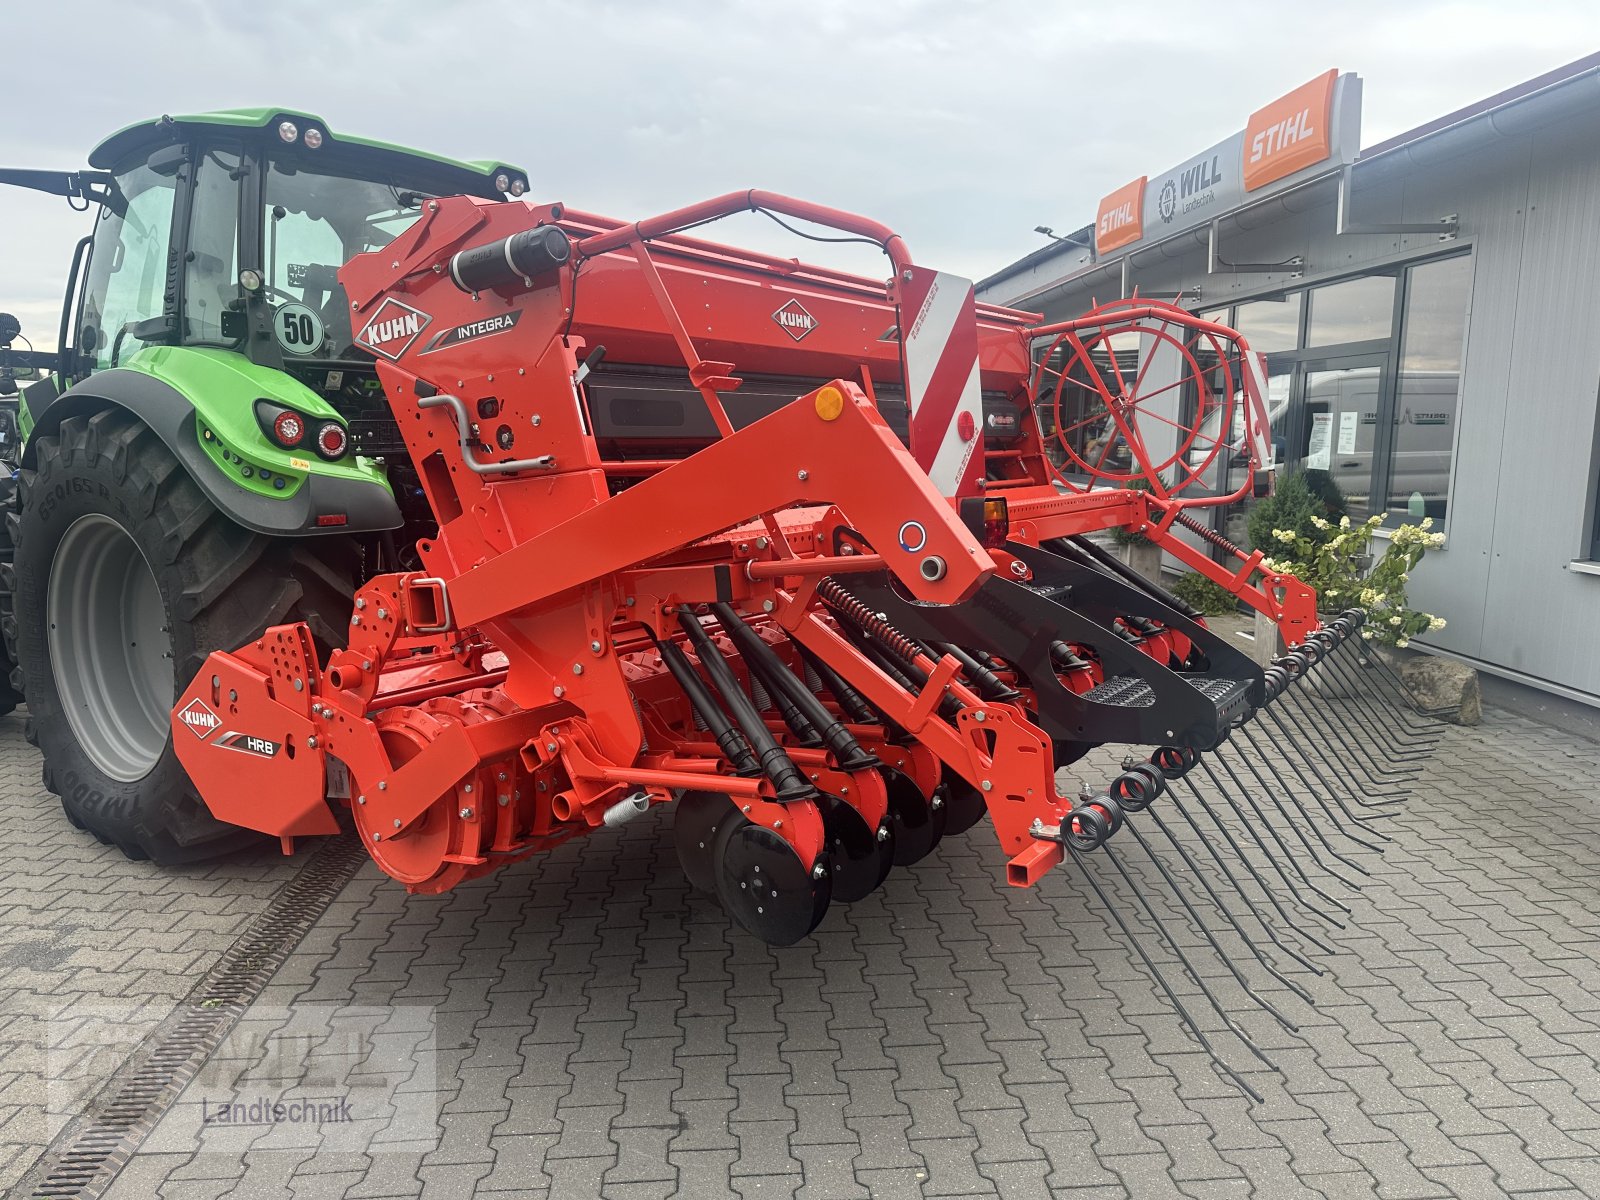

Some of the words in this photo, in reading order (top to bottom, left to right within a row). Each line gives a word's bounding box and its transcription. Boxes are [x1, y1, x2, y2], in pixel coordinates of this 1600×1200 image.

[1250, 108, 1314, 163] STIHL
[1181, 155, 1222, 199] WILL
[1182, 190, 1216, 215] Landtechnik
[1100, 202, 1133, 236] STIHL
[283, 312, 315, 346] 50
[367, 312, 419, 346] KUHN
[457, 314, 514, 339] INTEGRA
[780, 311, 811, 329] KUHN
[185, 710, 215, 728] KUHN
[247, 736, 274, 755] HRB
